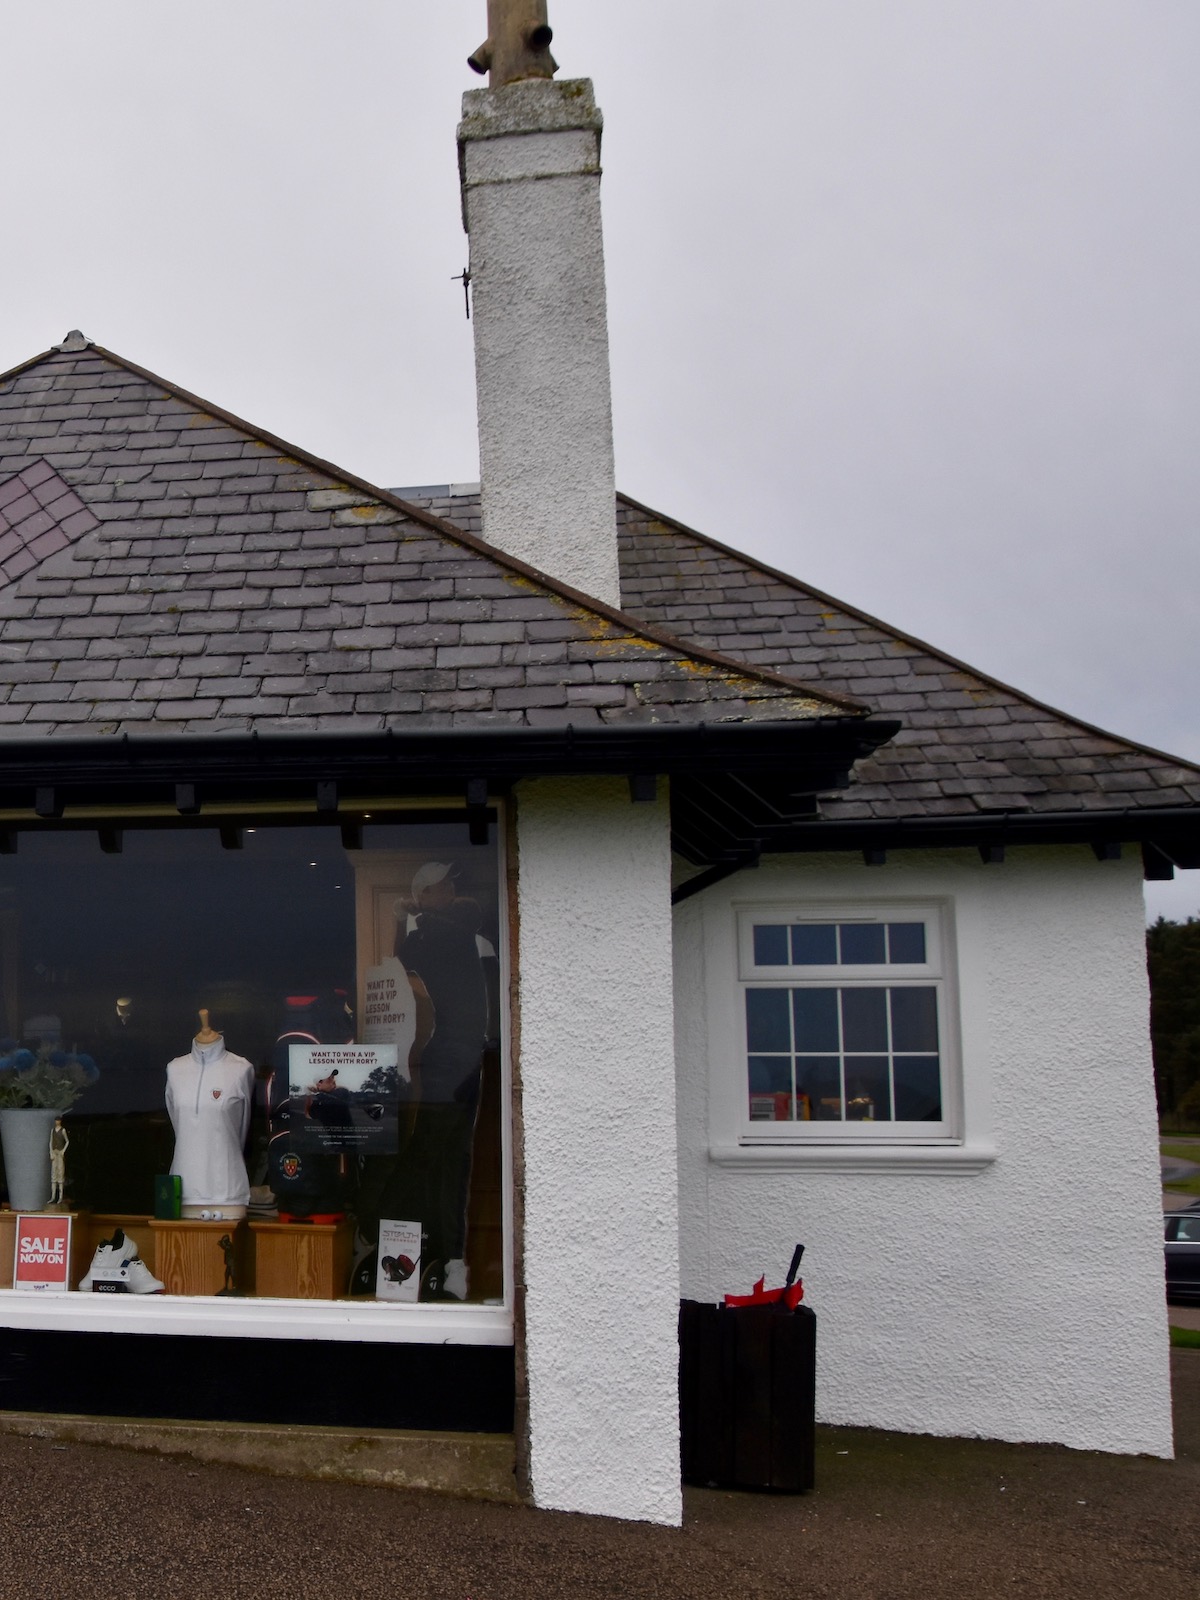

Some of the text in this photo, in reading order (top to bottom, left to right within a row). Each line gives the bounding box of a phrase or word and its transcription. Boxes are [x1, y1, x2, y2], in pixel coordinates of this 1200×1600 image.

[366, 978, 395, 990] WANT TO
[366, 992, 378, 1002] WIN
[386, 990, 397, 1000] VIP
[365, 1002, 390, 1014] LESSON
[365, 1013, 405, 1025] WITH RORY?
[20, 1236, 65, 1253] SALE
[20, 1253, 64, 1264] NOW ON
[98, 1284, 116, 1292] ecco
